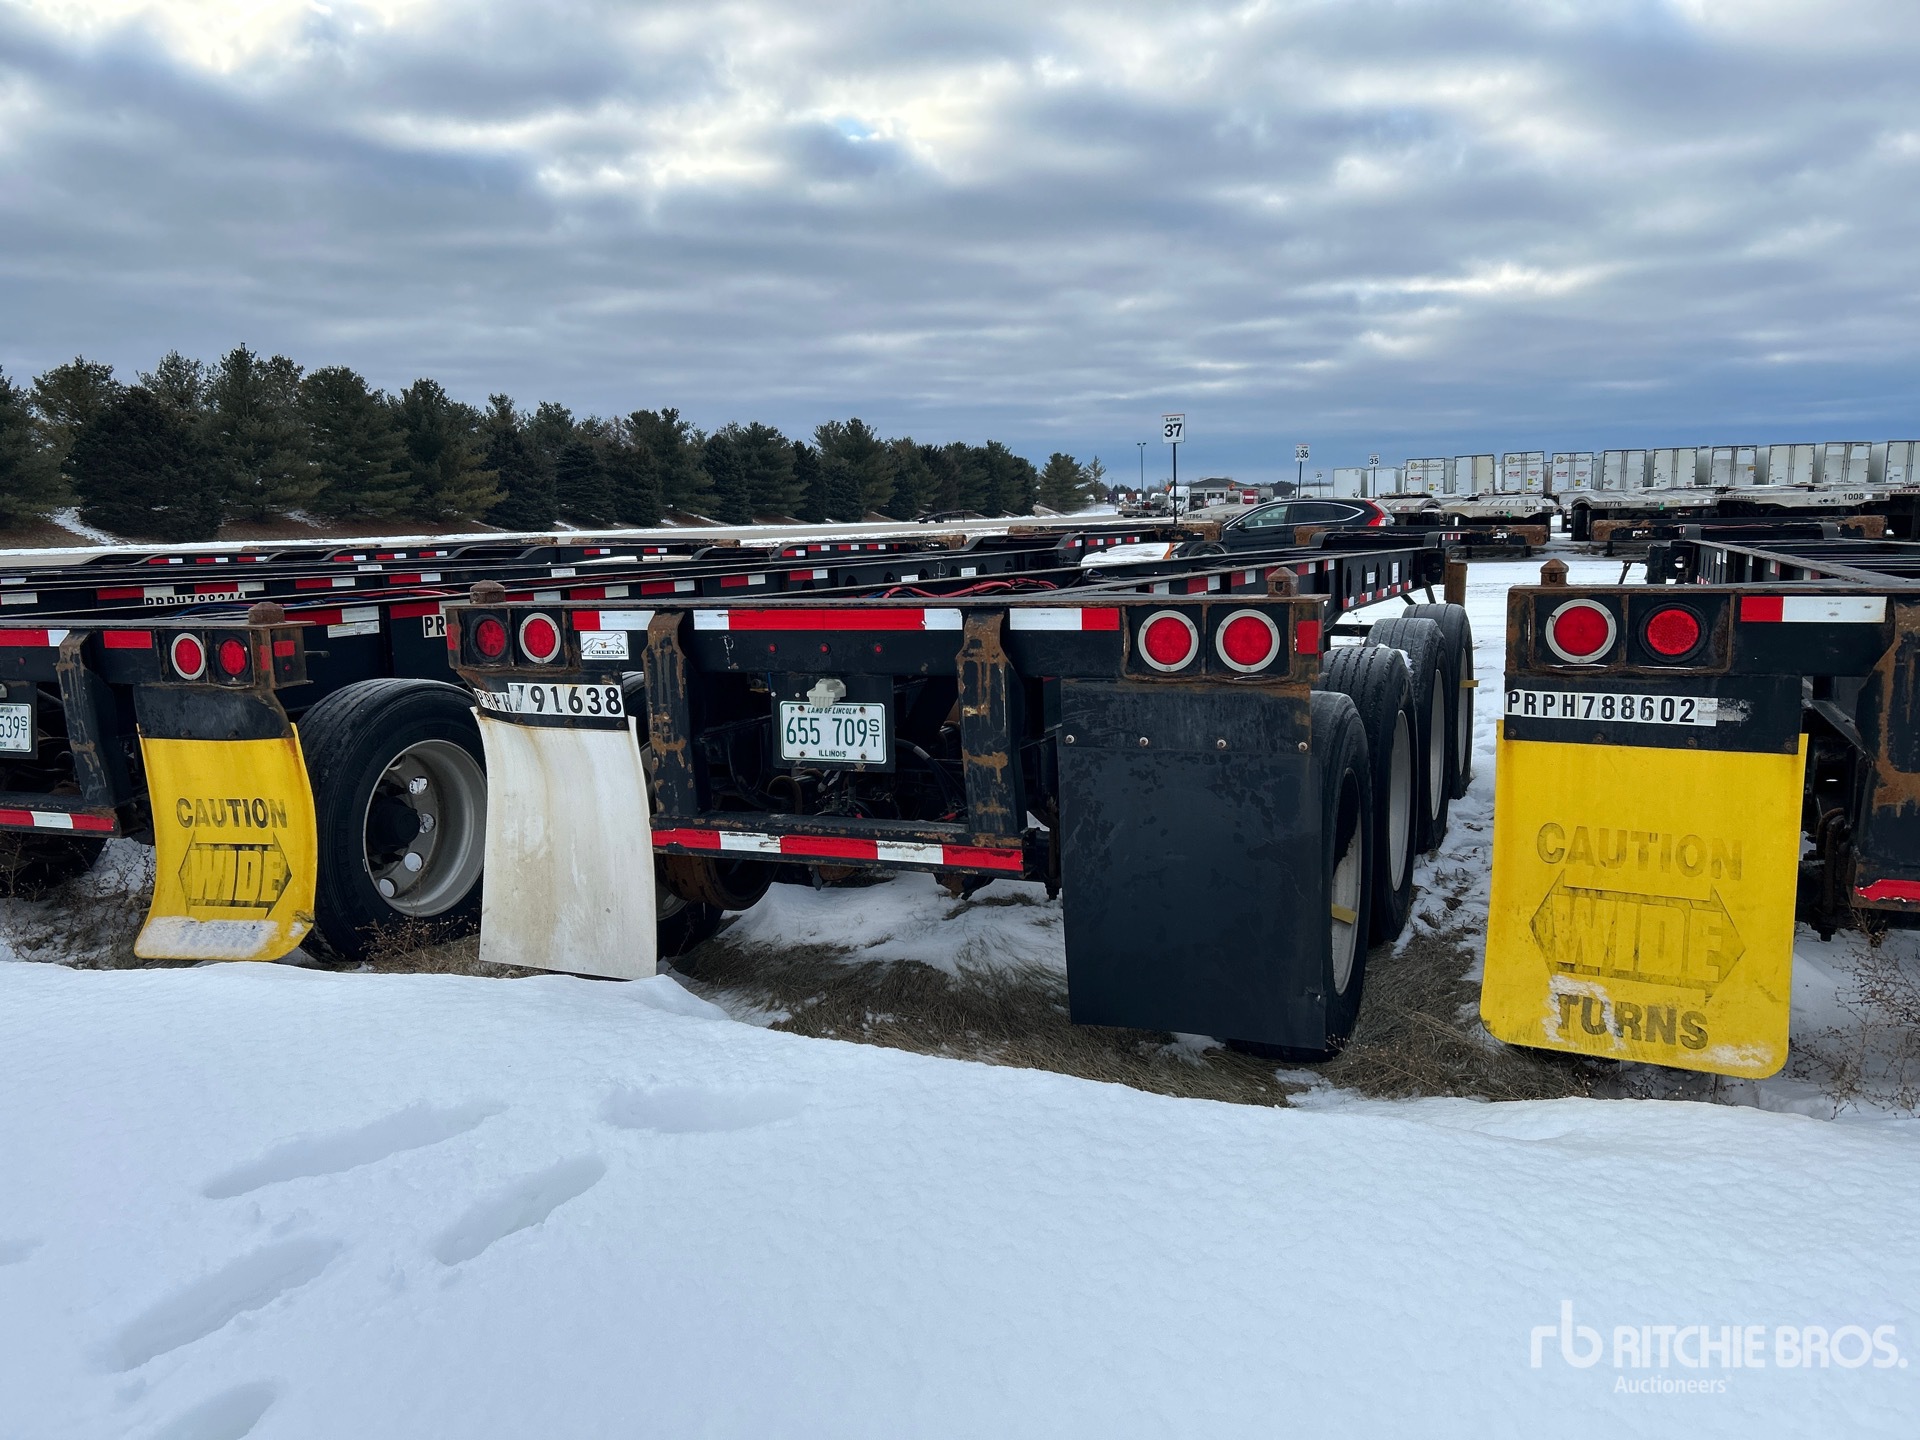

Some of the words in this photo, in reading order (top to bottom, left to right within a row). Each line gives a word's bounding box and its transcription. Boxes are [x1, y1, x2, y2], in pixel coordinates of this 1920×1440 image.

[1164, 423, 1183, 437] 37
[1300, 449, 1309, 459] 36
[807, 706, 824, 714] LAND
[832, 707, 858, 715] LINCOLN
[1507, 690, 1696, 723] PRPH788602
[786, 717, 820, 746] 655
[832, 717, 867, 747] 709
[818, 749, 847, 758] ILLINOIS
[175, 797, 288, 829] CAUTION
[1536, 822, 1743, 881] CAUTION
[188, 849, 282, 902] WIDE
[1551, 893, 1723, 983] WIDE
[1557, 993, 1709, 1050] TURNS
